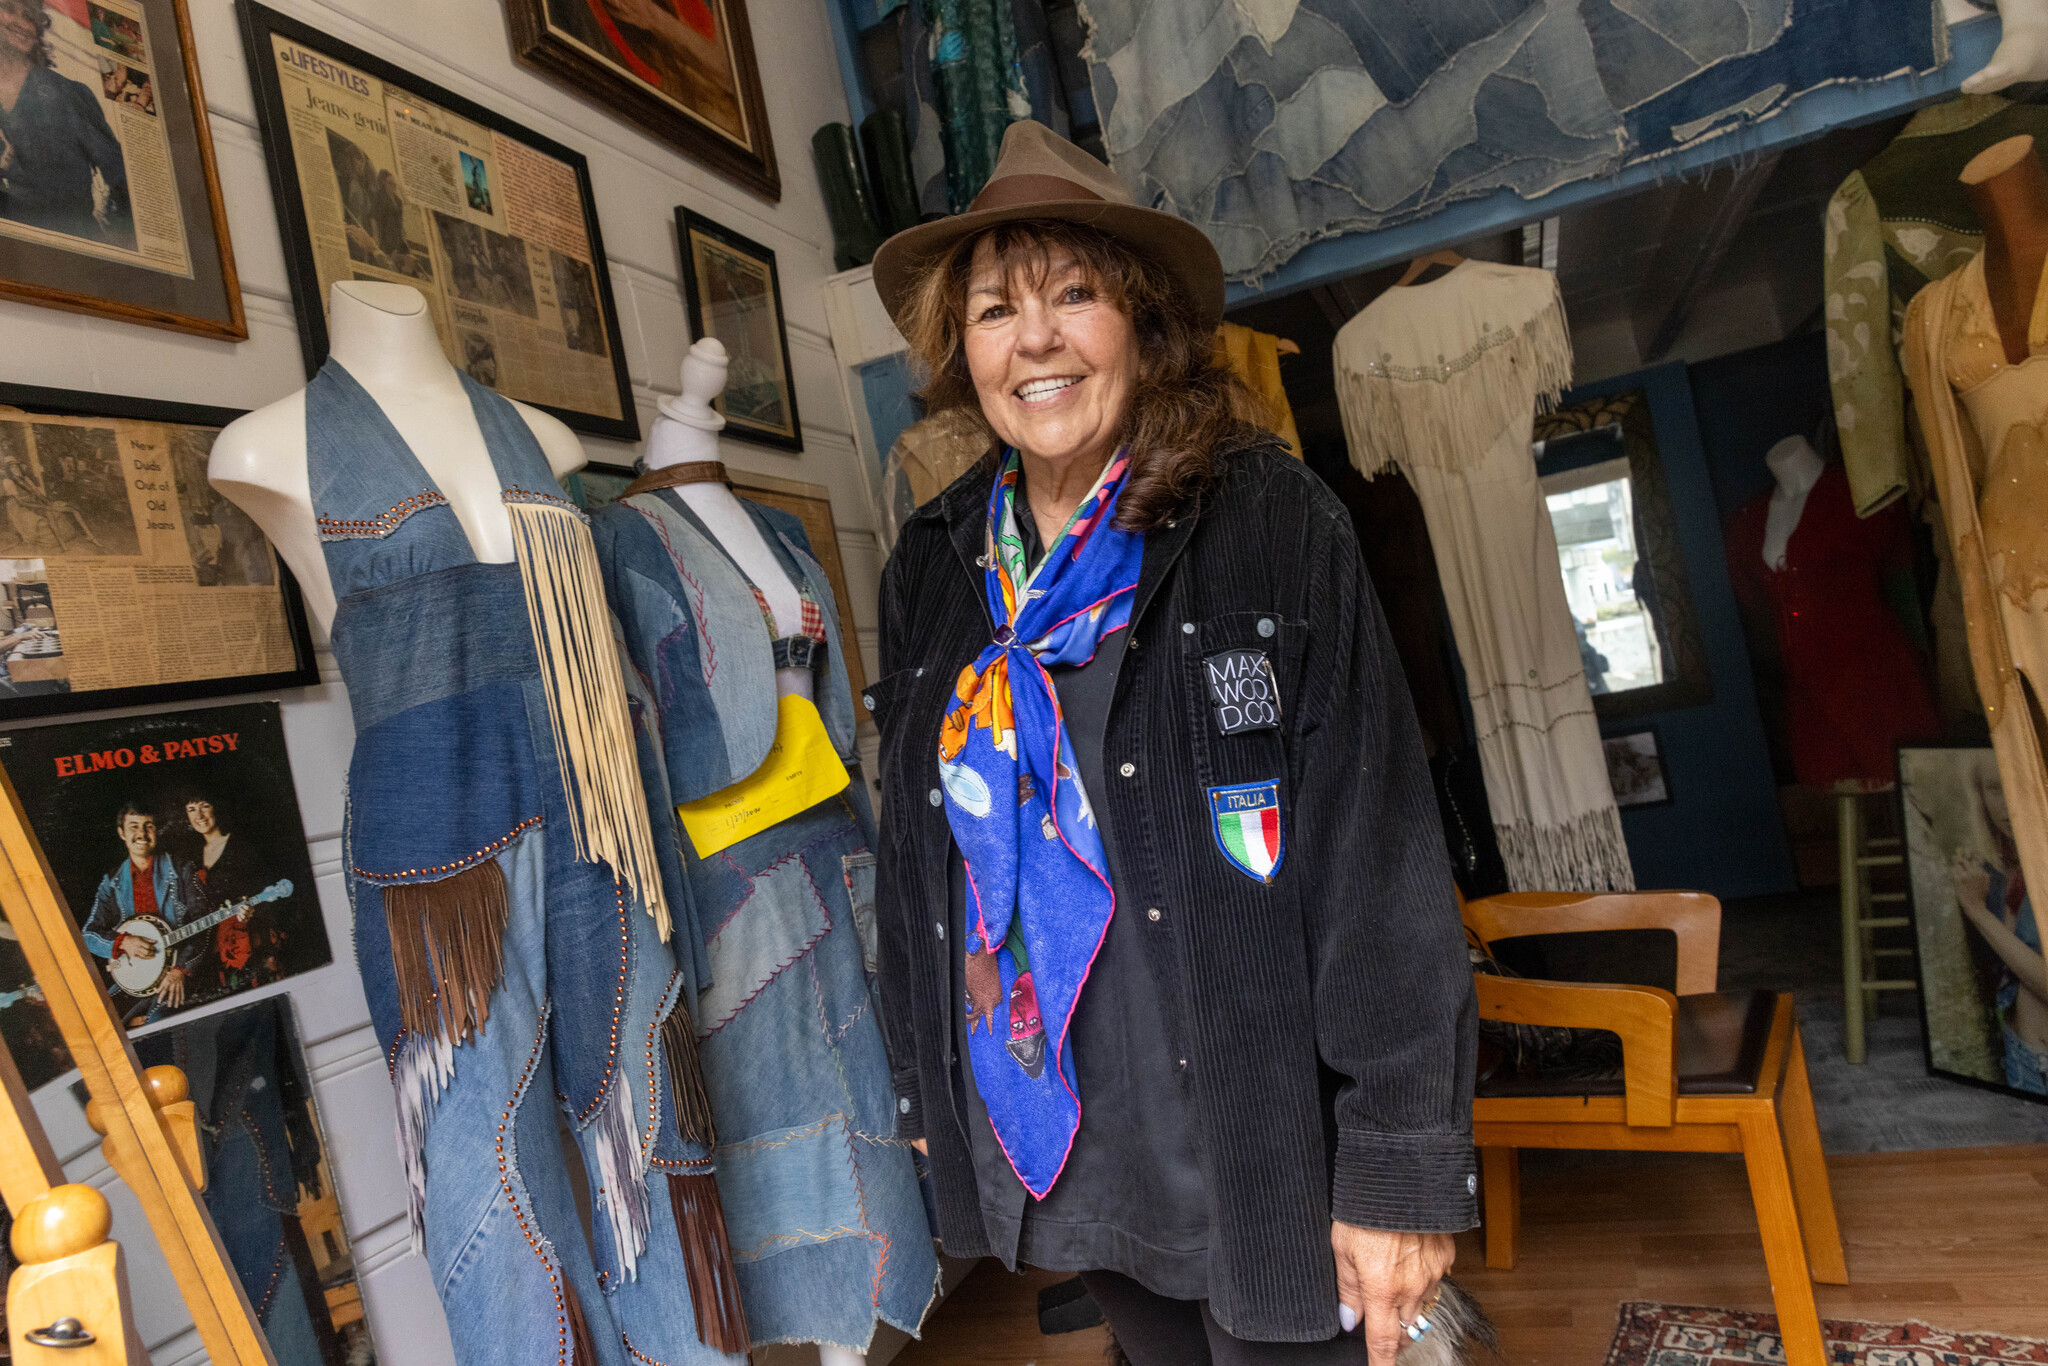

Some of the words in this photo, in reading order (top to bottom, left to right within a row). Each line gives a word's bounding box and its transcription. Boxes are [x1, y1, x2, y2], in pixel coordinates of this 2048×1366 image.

[289, 47, 370, 97] LIFESTYLES
[306, 87, 350, 120] Jeans
[131, 440, 154, 451] New
[134, 459, 161, 471] Duds
[135, 480, 157, 490] Out
[159, 481, 170, 491] of
[147, 500, 166, 511] Old
[147, 519, 175, 530] Jeans
[1208, 655, 1267, 685] MAX
[54, 748, 135, 777] ELMO
[140, 744, 161, 764] &
[163, 733, 239, 760] PATSY
[1227, 792, 1266, 809] ITALIA
